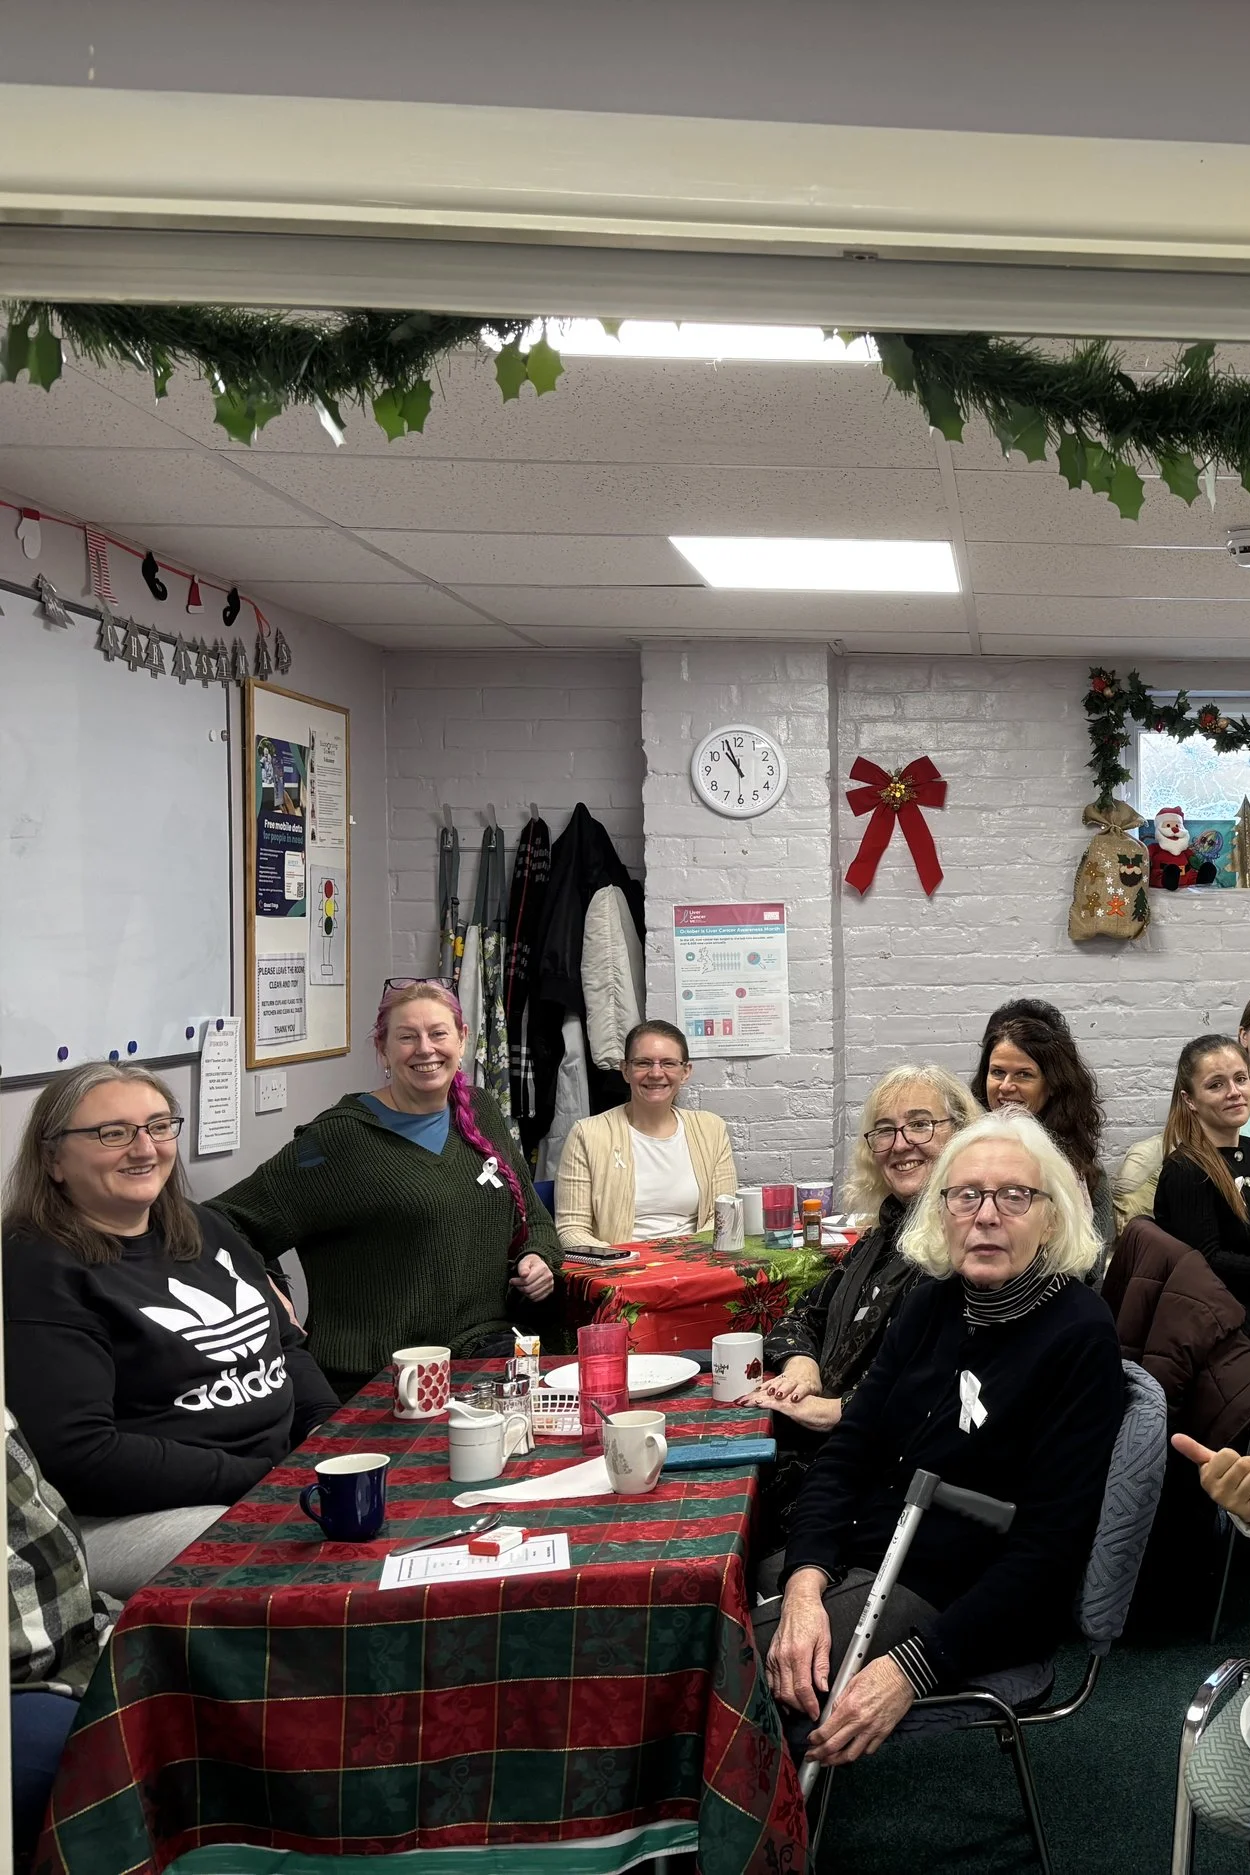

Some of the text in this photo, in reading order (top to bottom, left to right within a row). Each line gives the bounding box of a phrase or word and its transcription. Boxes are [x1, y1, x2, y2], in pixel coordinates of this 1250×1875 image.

[732, 736, 744, 748] 12
[751, 740, 756, 751] 1
[709, 751, 720, 762] 10
[761, 751, 769, 762] 2
[704, 765, 712, 776] 9
[766, 765, 775, 776] 3
[710, 780, 718, 791] 8
[762, 780, 770, 791] 4
[723, 790, 731, 801] 7
[737, 793, 745, 805] 6
[751, 790, 759, 801] 5
[264, 818, 303, 833] Free mobile data
[270, 832, 286, 844] people
[259, 966, 275, 975] PLEASE
[276, 966, 287, 975] LEAVE
[269, 980, 282, 989] CLEAN
[282, 980, 290, 988] AND
[274, 1024, 295, 1034] THANK YOU
